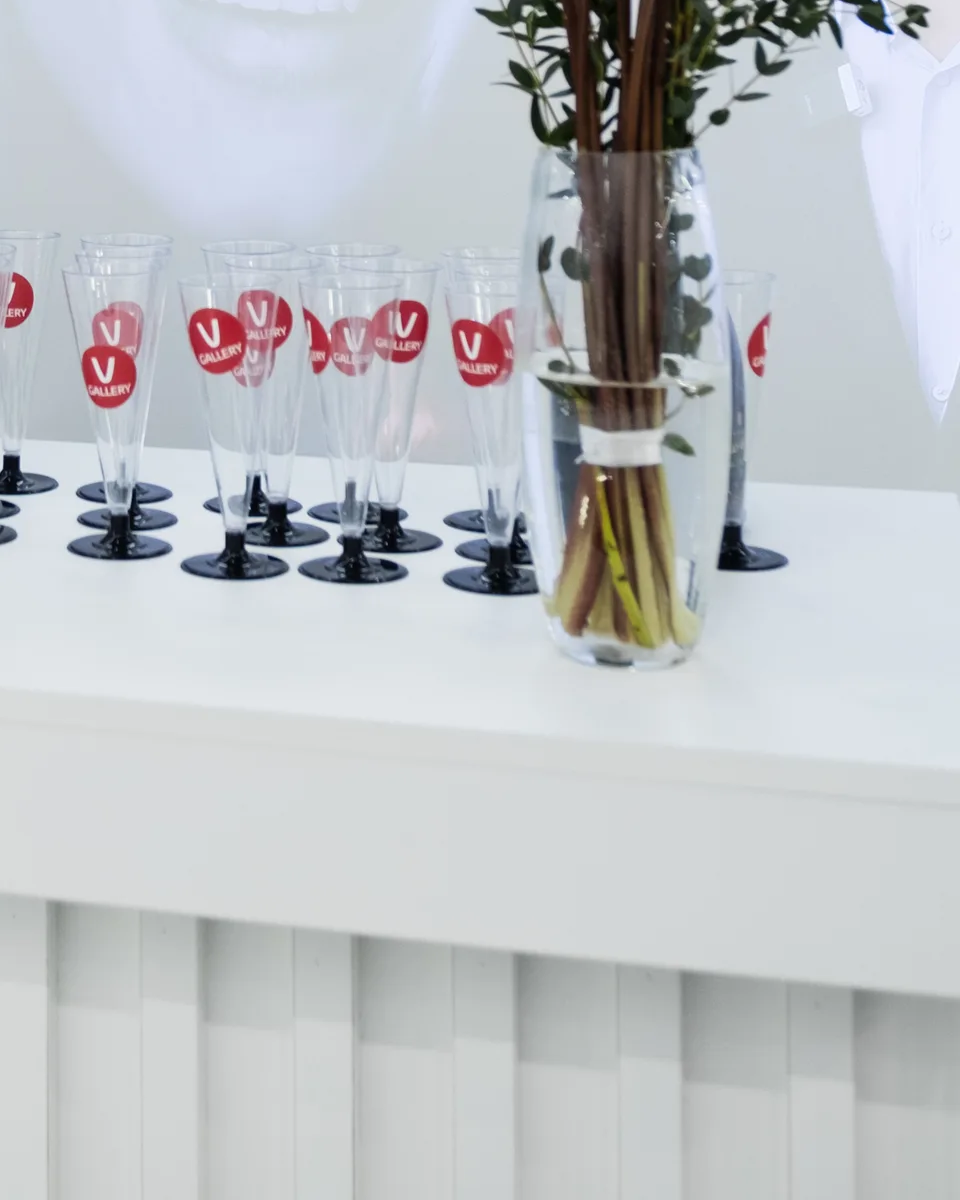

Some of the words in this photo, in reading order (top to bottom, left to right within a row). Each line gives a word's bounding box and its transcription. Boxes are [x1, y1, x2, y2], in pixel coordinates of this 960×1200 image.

[246, 300, 268, 328] V
[99, 319, 121, 347] V
[196, 318, 221, 349] V
[458, 330, 482, 360] V
[199, 342, 243, 366] GALLERY
[91, 356, 115, 384] V
